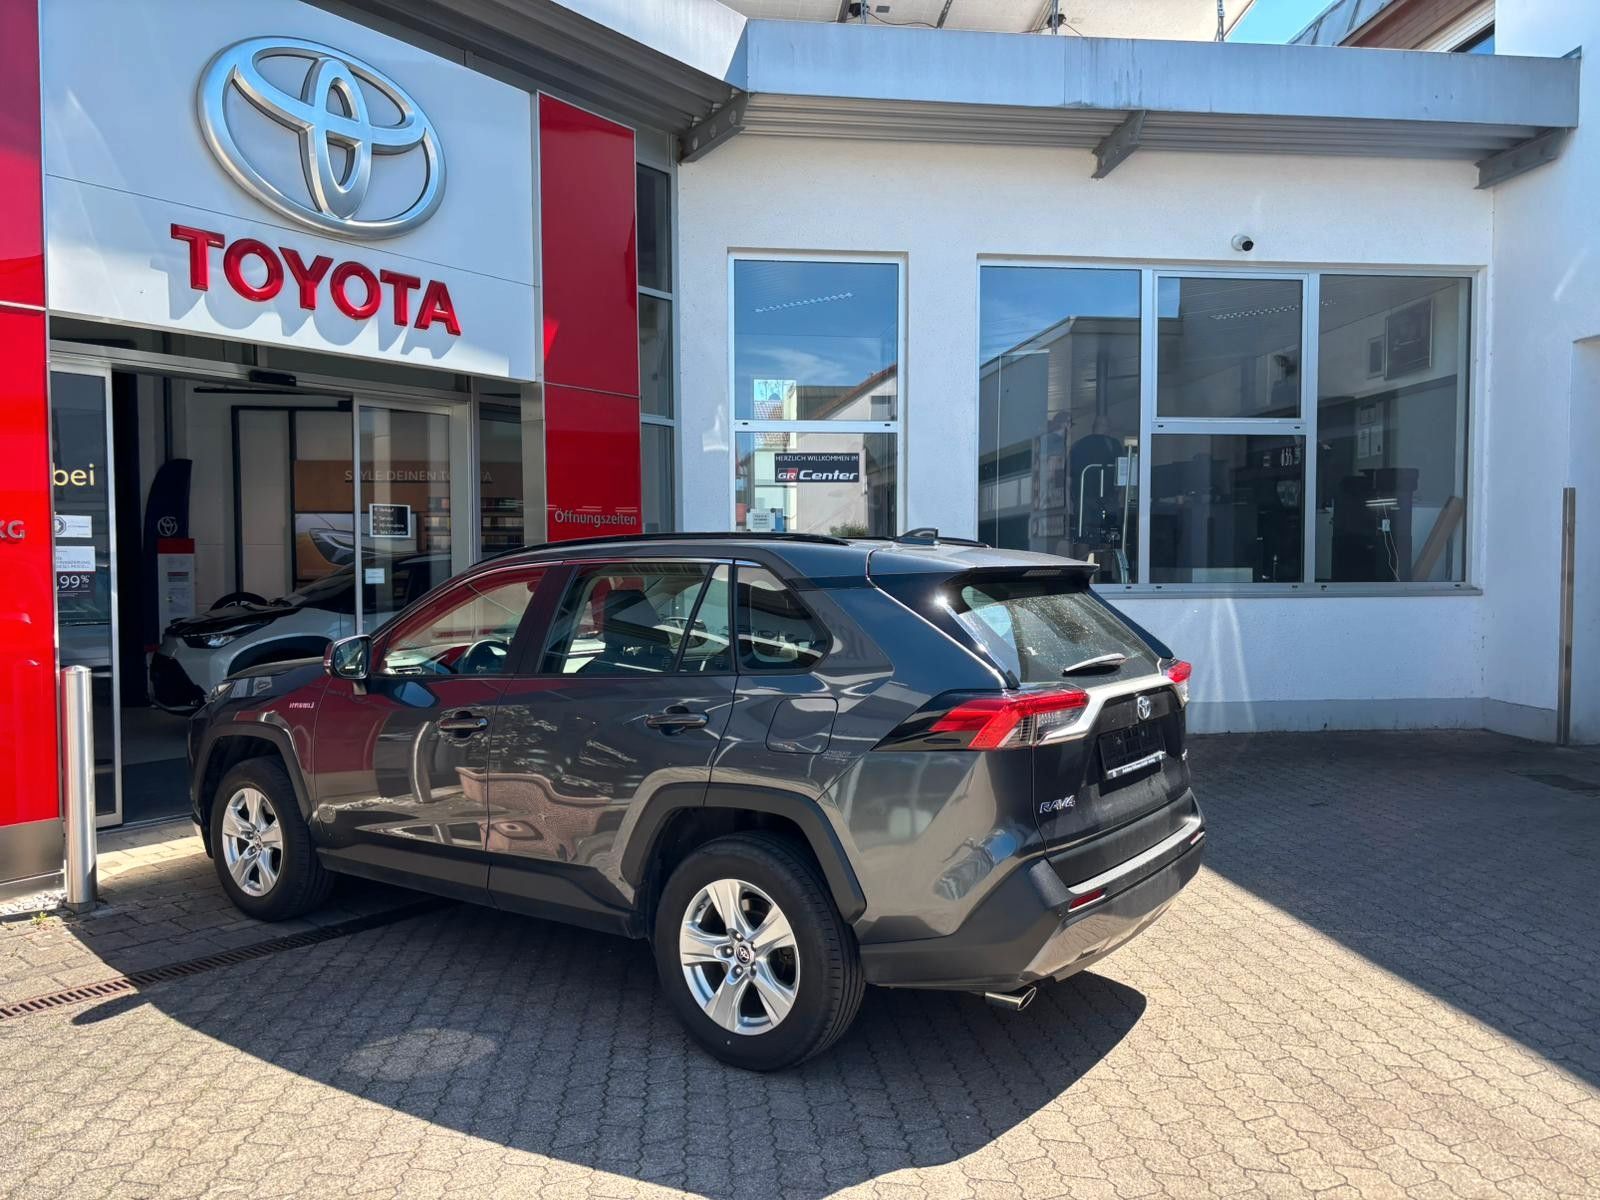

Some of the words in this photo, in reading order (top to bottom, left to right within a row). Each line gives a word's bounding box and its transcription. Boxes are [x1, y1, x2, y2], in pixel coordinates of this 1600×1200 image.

[171, 223, 461, 336] TOYOTA
[53, 462, 95, 486] bei
[344, 470, 382, 481] SYLE
[386, 470, 437, 481] DEINEN
[799, 470, 859, 480] Center
[555, 508, 637, 527] Öffnungszeiten
[1040, 795, 1075, 813] RAV4
